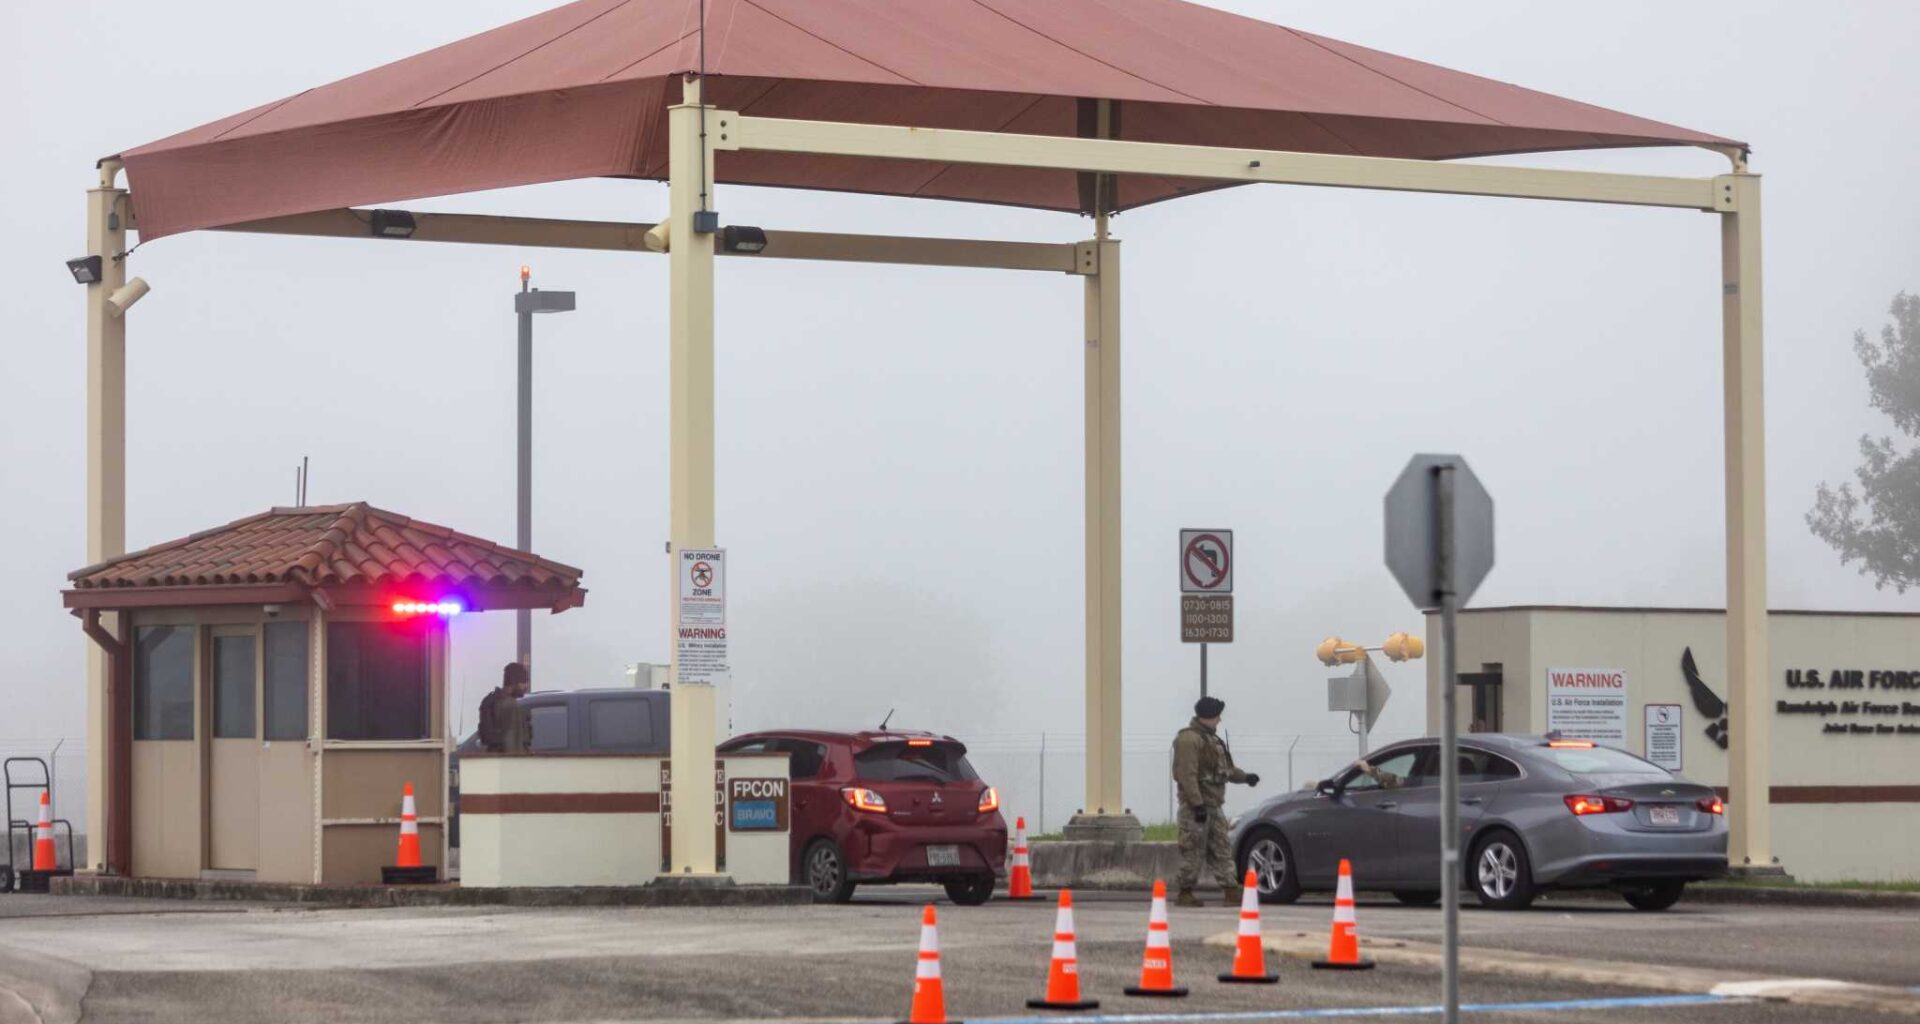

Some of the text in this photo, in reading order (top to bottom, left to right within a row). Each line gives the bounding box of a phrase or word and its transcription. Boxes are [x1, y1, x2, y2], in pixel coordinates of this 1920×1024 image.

[678, 628, 726, 639] WARNING
[1552, 673, 1622, 688] WARNING
[1786, 669, 1825, 689] U.S.
[1829, 670, 1864, 690] AIR
[1777, 700, 1838, 716] Randolph
[1841, 701, 1860, 714] Air
[1862, 702, 1899, 714] Force
[733, 781, 784, 797] FPCON
[737, 809, 775, 820] BRAVO
